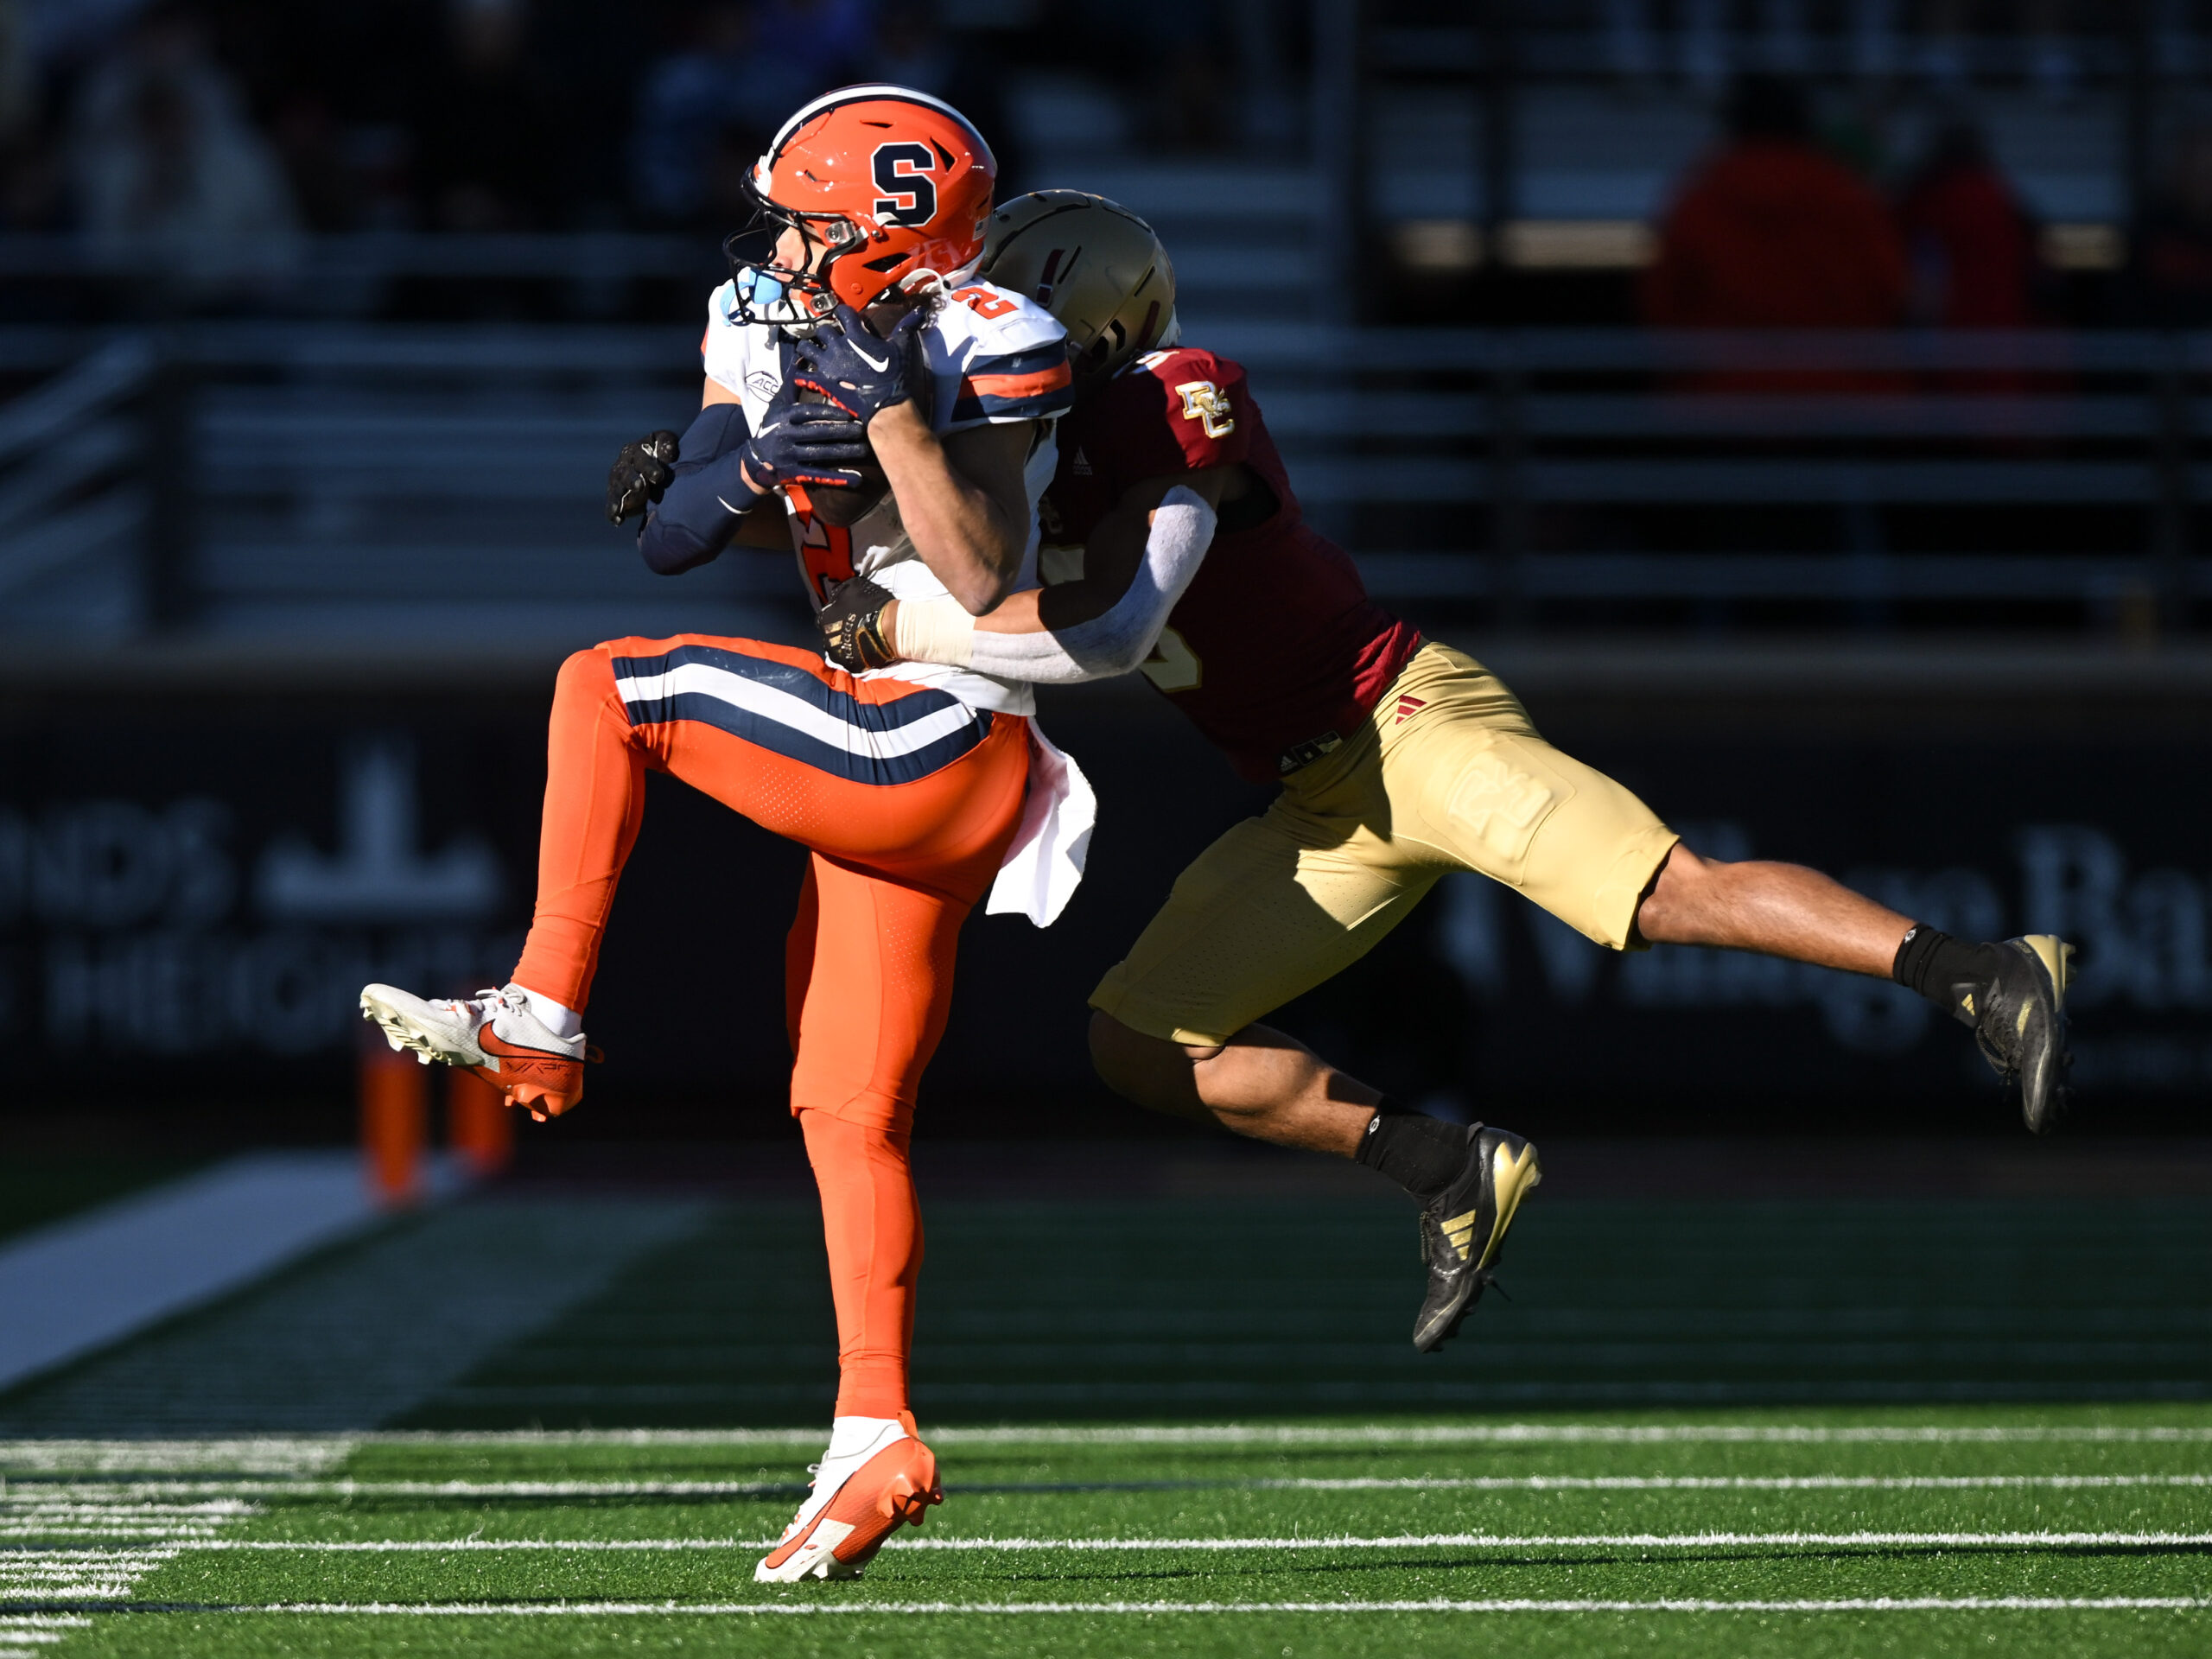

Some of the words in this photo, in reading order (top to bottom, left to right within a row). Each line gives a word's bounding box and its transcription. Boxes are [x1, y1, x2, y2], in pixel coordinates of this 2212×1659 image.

[870, 142, 937, 228] S
[950, 287, 1019, 320] 2
[752, 378, 779, 395] ACC
